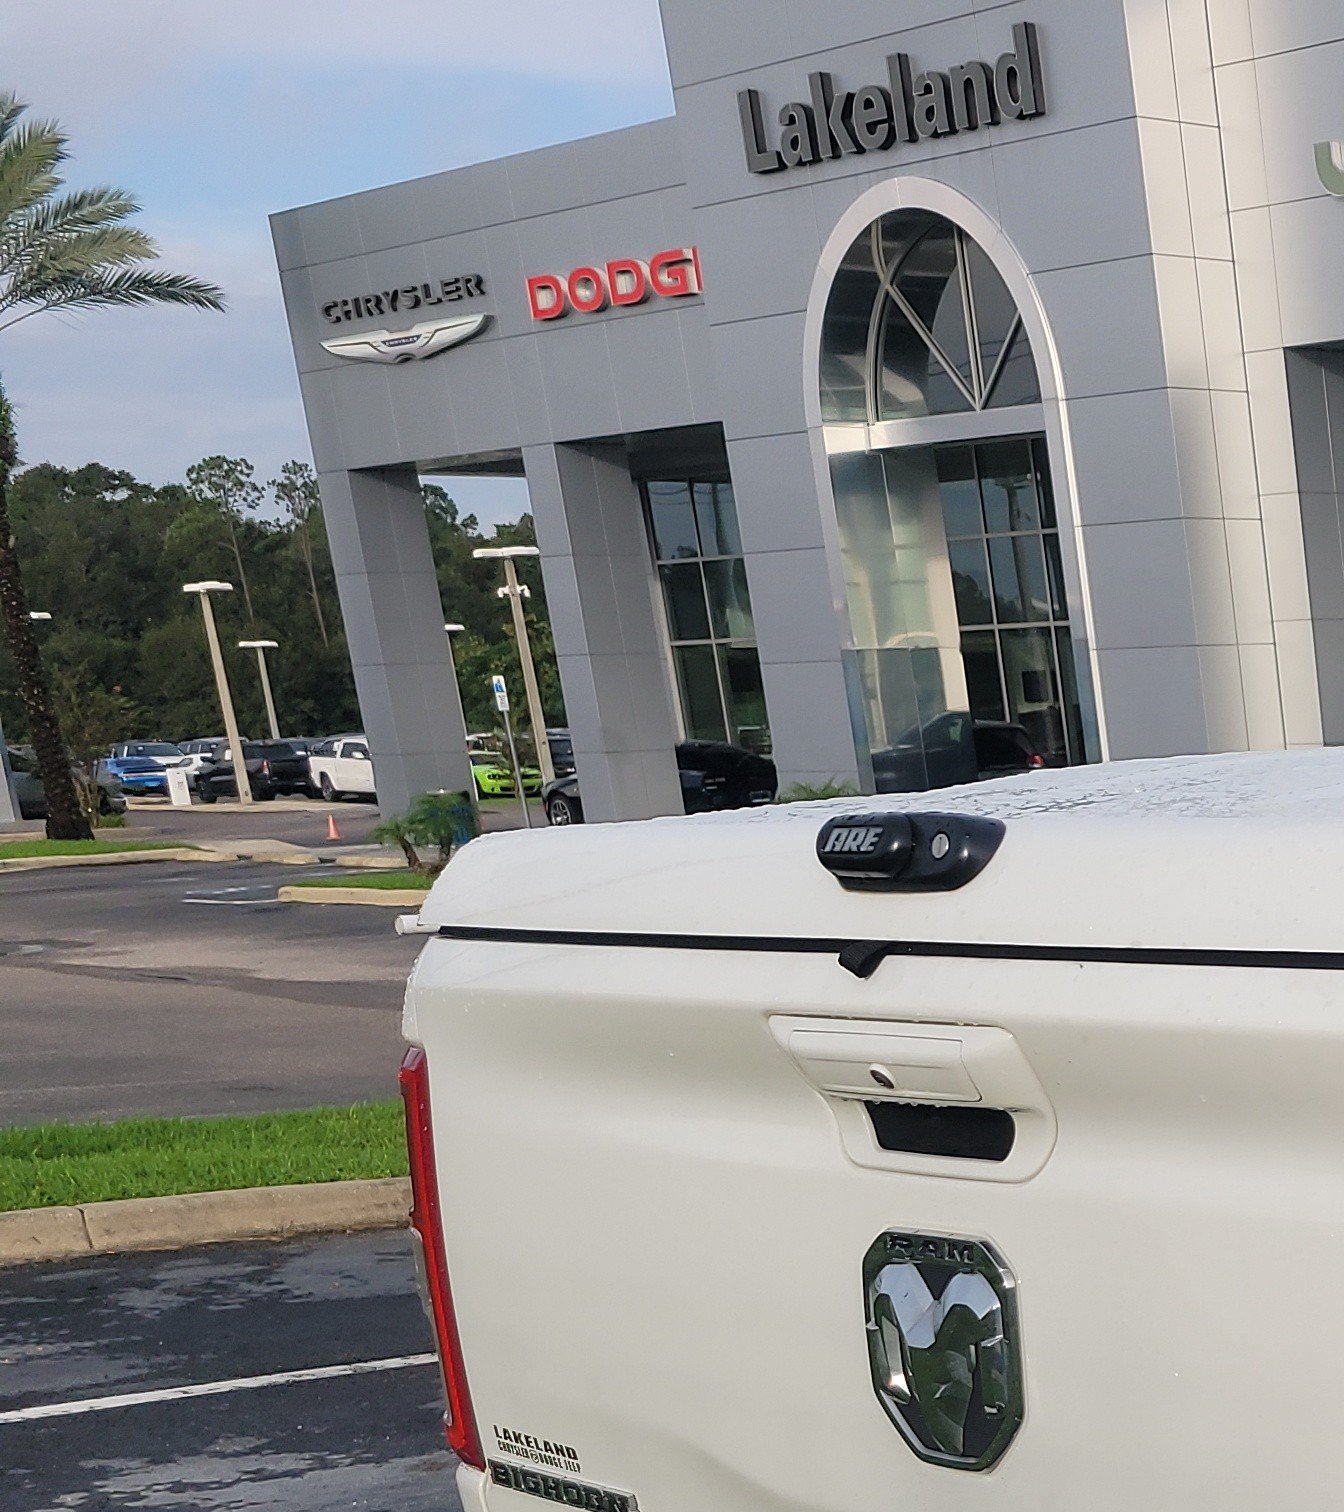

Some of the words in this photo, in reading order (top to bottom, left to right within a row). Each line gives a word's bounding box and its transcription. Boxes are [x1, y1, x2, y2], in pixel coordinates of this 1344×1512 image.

[736, 21, 1046, 174] Lakeland
[321, 272, 488, 325] CHRYSLER
[821, 826, 885, 853] ARE
[884, 1235, 976, 1265] RAM
[493, 1424, 579, 1461] LAKELAND
